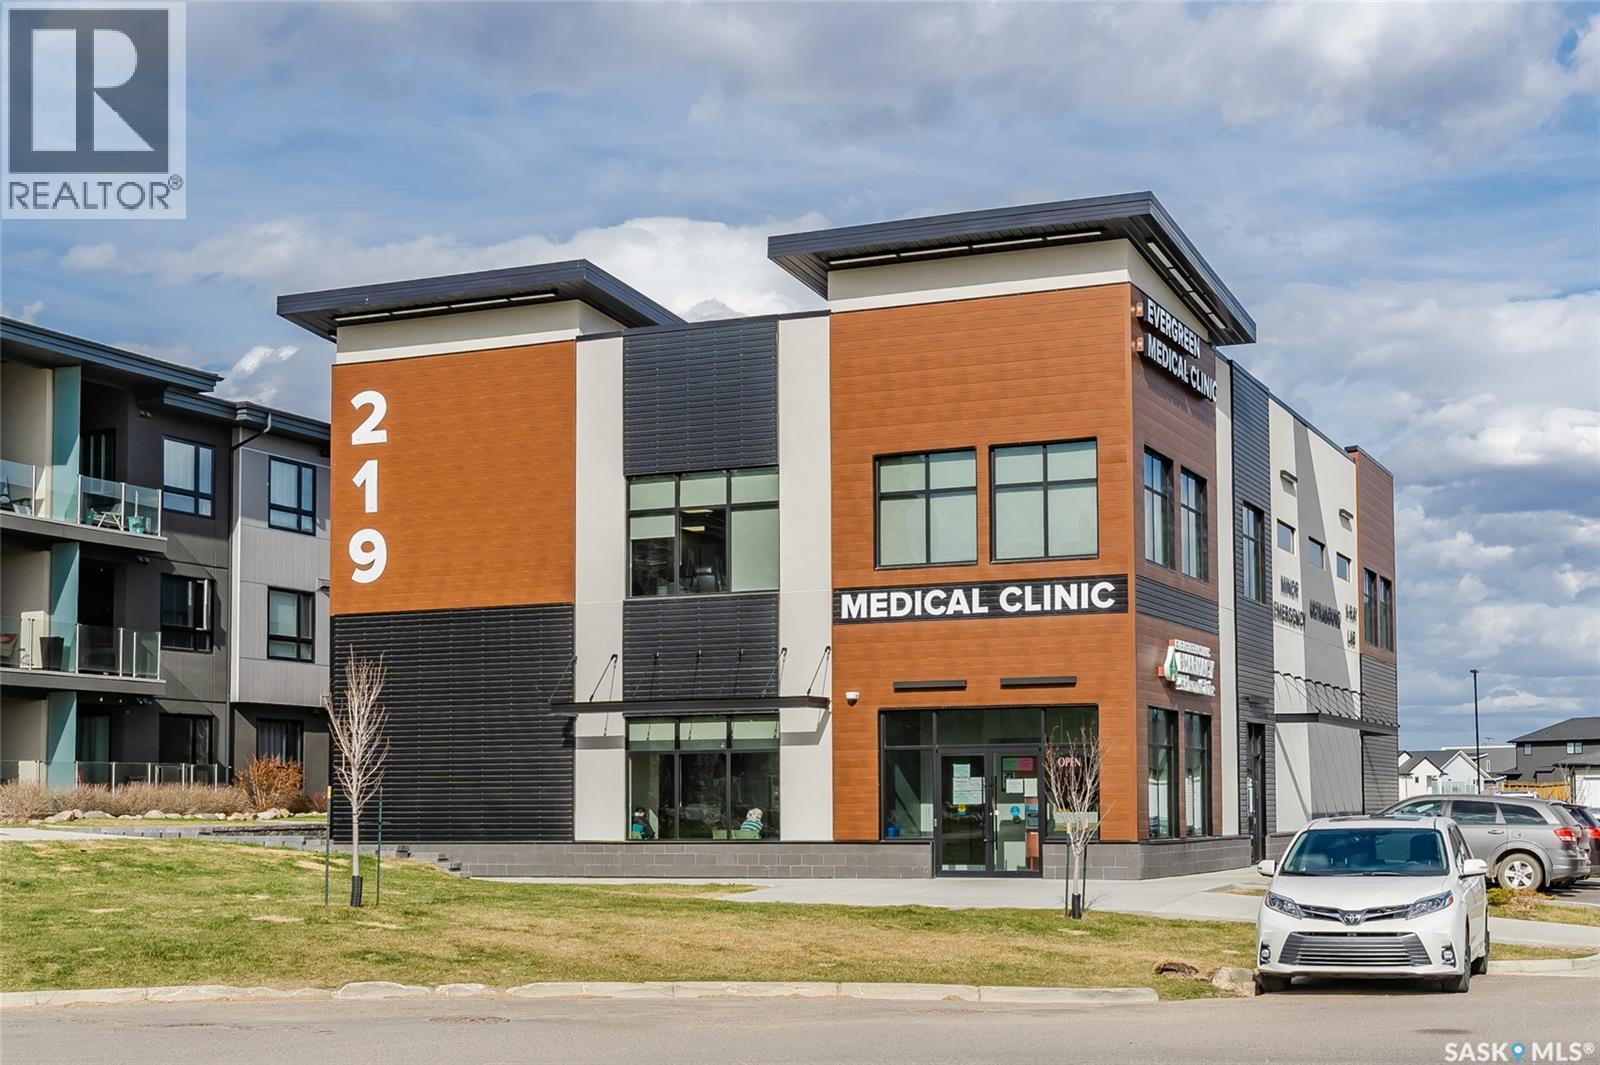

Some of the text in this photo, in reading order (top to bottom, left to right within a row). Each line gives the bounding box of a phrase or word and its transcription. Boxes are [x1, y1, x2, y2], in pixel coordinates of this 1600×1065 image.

[1147, 298, 1201, 359] EVERGREEN
[1147, 333, 1218, 402] MEDICAL CLINIC
[840, 581, 1116, 620] MEDICAL CLINIC
[1057, 757, 1082, 767] OPEN
